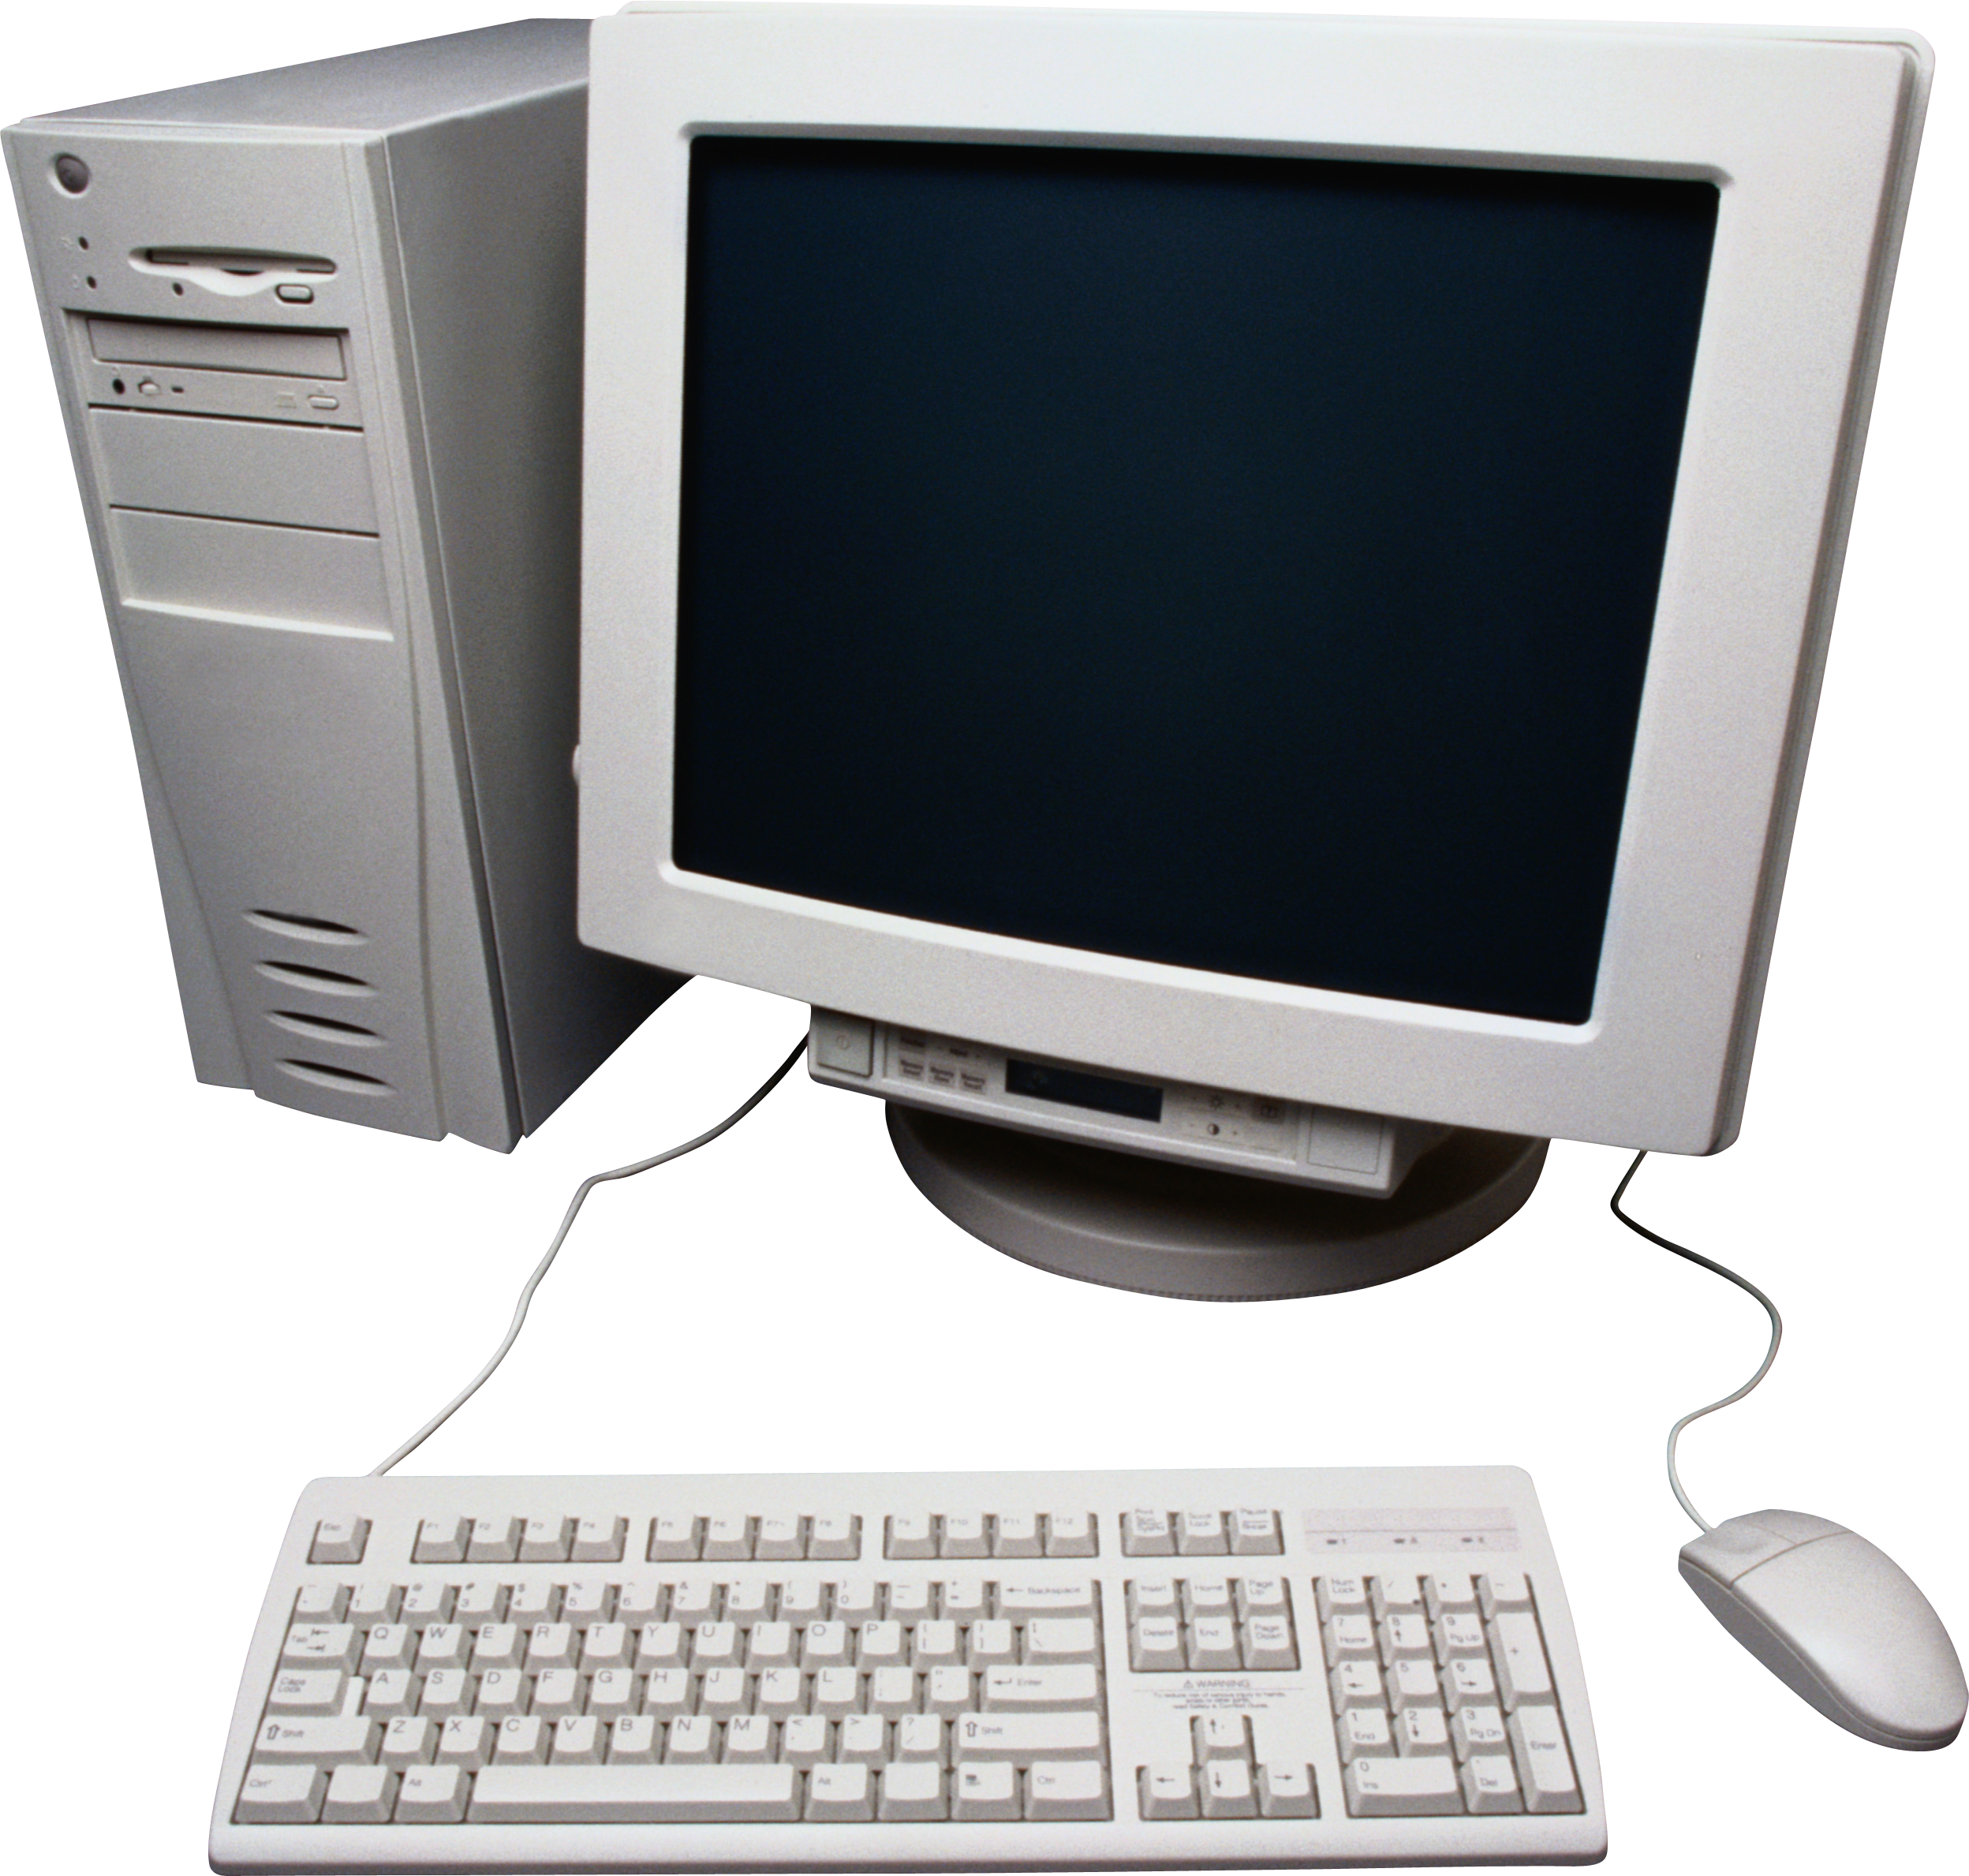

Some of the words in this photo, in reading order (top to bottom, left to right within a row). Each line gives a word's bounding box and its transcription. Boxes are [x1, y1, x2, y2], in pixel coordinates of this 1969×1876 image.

[518, 1582, 525, 1593] $
[573, 1582, 583, 1590] %
[679, 1581, 688, 1590] &
[409, 1598, 417, 1607] 2
[461, 1598, 469, 1607] 3
[514, 1598, 522, 1607] 4
[569, 1598, 577, 1606] 5
[623, 1597, 631, 1605] 6
[731, 1596, 740, 1605] 8
[786, 1596, 794, 1605] 9
[1337, 1617, 1343, 1627] 7
[1392, 1616, 1400, 1626] 8
[1447, 1616, 1455, 1626] 9
[374, 1627, 388, 1640] Q
[430, 1627, 446, 1638] W
[483, 1627, 495, 1638] E
[536, 1626, 549, 1637] R
[594, 1626, 605, 1637] T
[648, 1626, 659, 1637] Y
[702, 1625, 715, 1637] U
[757, 1625, 761, 1636] I
[812, 1624, 826, 1637] O
[867, 1624, 878, 1635] P
[292, 1635, 308, 1643] Tab
[1450, 1634, 1463, 1643] Pg
[1344, 1664, 1353, 1673] 4
[1400, 1663, 1409, 1672] 5
[1456, 1662, 1466, 1672] 6
[281, 1677, 306, 1686] Caps
[376, 1672, 389, 1684] A
[432, 1672, 443, 1684] S
[488, 1672, 500, 1684] D
[543, 1672, 554, 1683] F
[599, 1671, 613, 1684] G
[654, 1671, 668, 1683] H
[710, 1671, 719, 1683] J
[766, 1671, 778, 1682] K
[823, 1671, 832, 1683] L
[1196, 1679, 1250, 1688] WARNING
[1351, 1712, 1358, 1721] 1
[1409, 1711, 1418, 1720] 2
[1466, 1710, 1475, 1720] 3
[450, 1720, 462, 1732] X
[506, 1719, 520, 1732] C
[564, 1719, 577, 1731] V
[621, 1719, 633, 1731] B
[678, 1719, 691, 1731] N
[734, 1718, 750, 1730] M
[907, 1717, 914, 1726] ?
[394, 1721, 405, 1733] Z
[981, 1725, 1003, 1736] Shift
[1354, 1732, 1375, 1740] End
[1470, 1728, 1484, 1739] Pg
[1530, 1740, 1556, 1750] Enter
[1360, 1762, 1369, 1772] 0
[409, 1778, 422, 1787] Alt
[818, 1777, 831, 1785] Alt
[1037, 1775, 1055, 1784] Ctrl
[1480, 1777, 1498, 1787] Del
[1363, 1781, 1379, 1789] Ins
